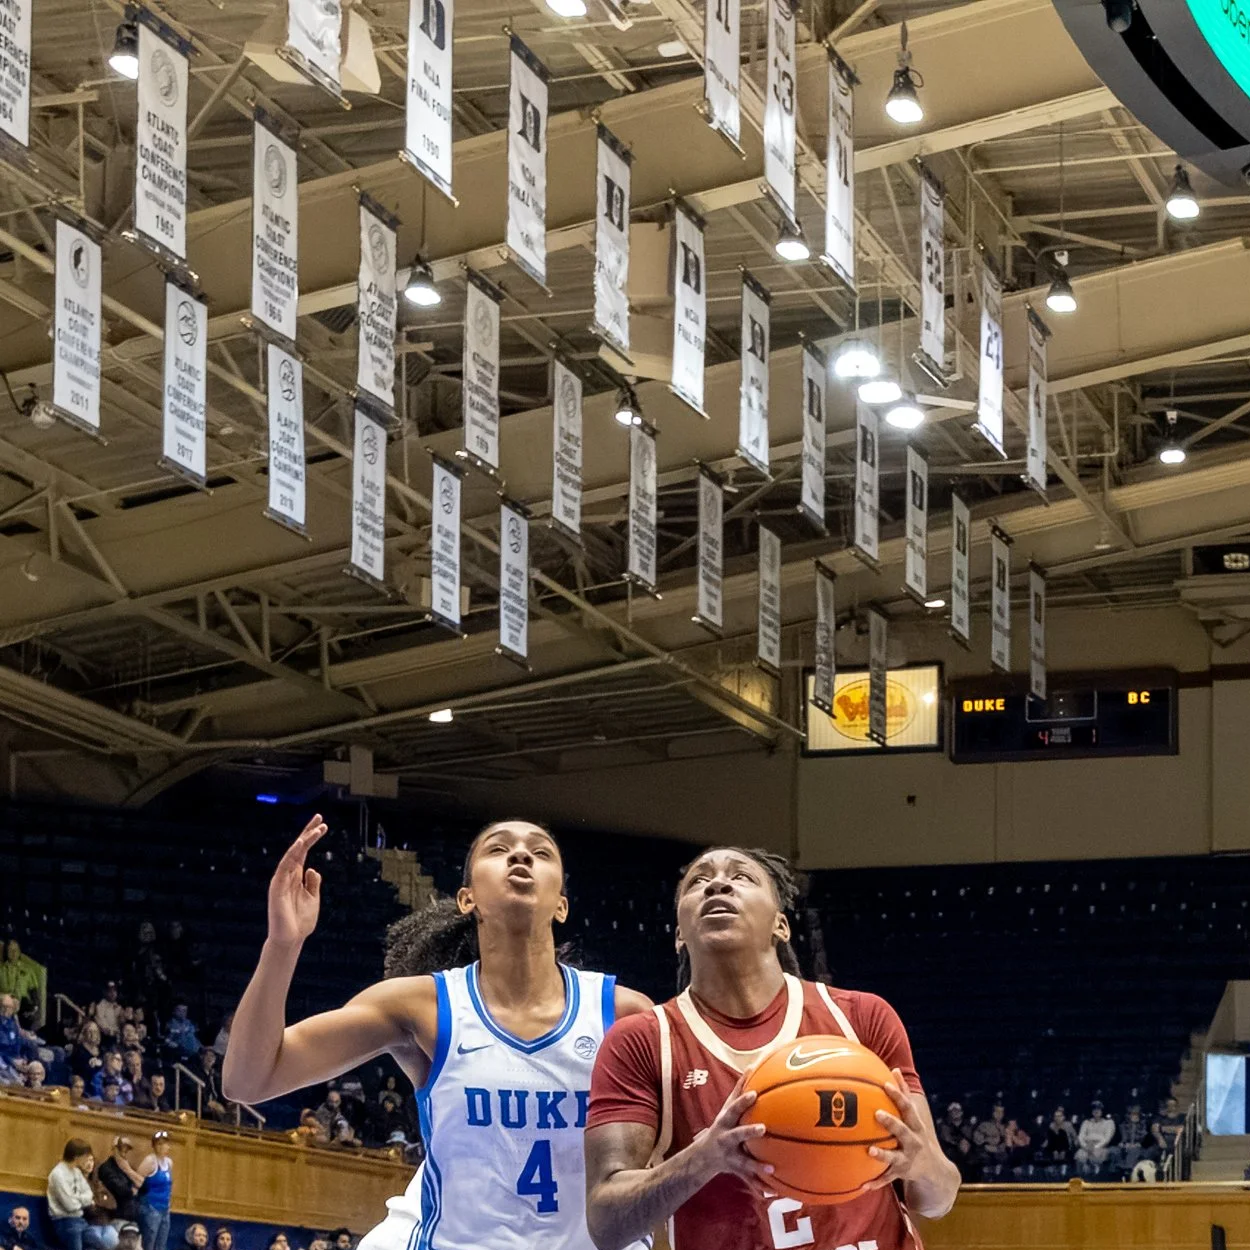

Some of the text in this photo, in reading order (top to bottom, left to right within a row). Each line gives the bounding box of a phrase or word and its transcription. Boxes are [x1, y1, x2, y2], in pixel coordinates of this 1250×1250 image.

[1128, 691, 1150, 704] BC
[963, 698, 1006, 713] DUKE
[517, 1140, 558, 1213] 4
